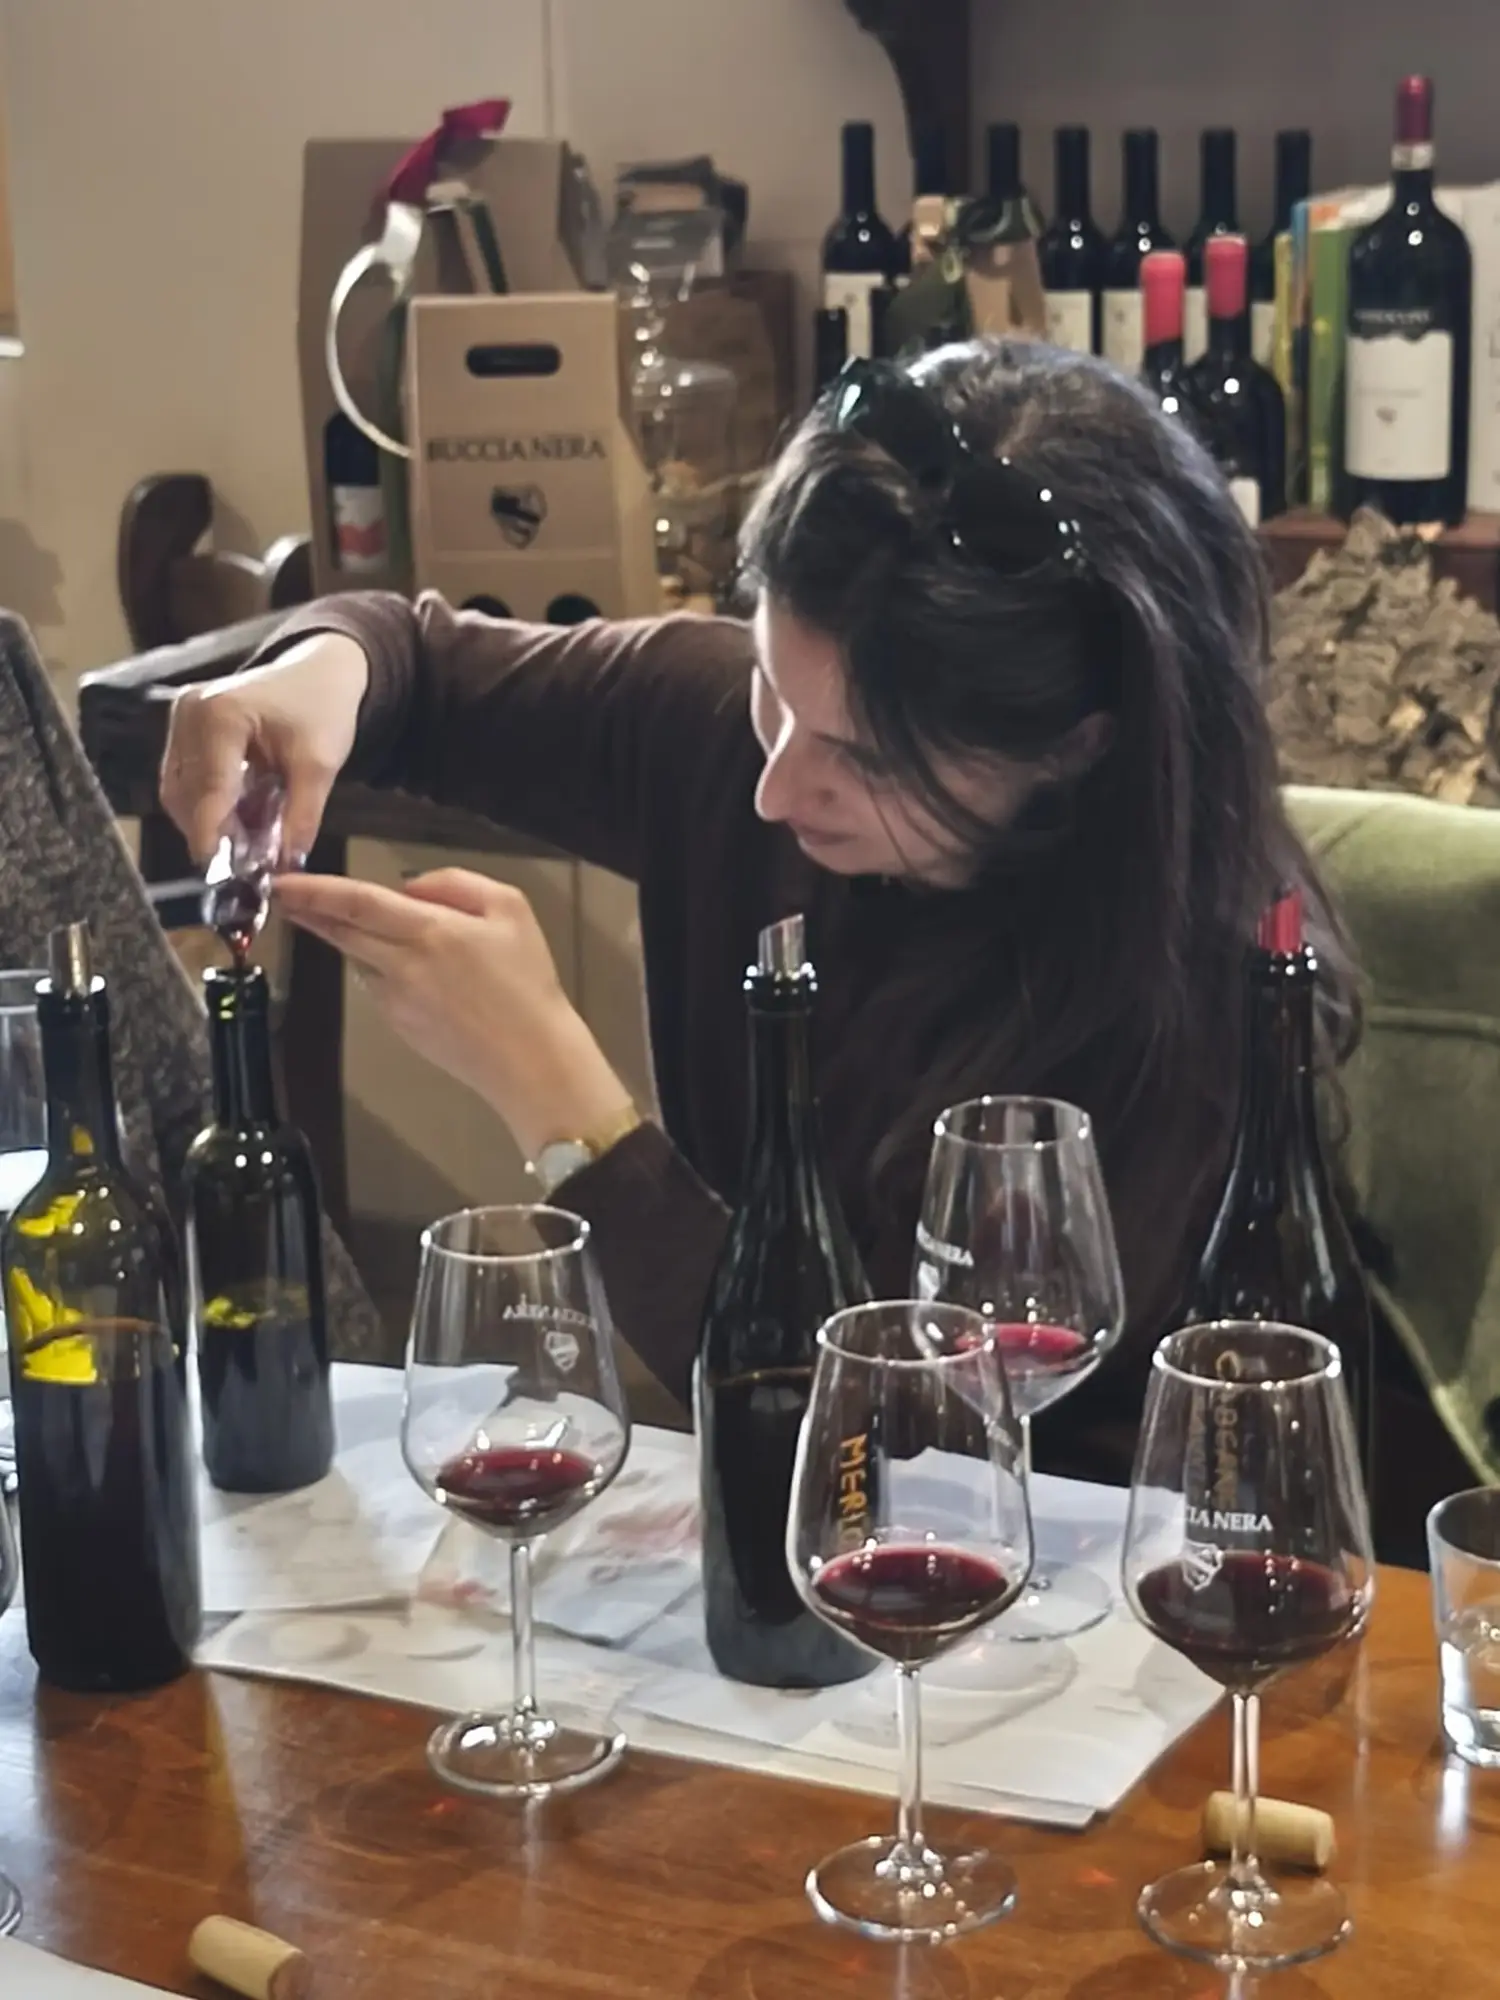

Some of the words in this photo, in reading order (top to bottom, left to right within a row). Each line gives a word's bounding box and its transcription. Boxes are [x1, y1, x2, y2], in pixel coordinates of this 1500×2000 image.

[427, 437, 527, 462] BUCCIA
[531, 434, 607, 461] NERA
[1211, 1510, 1273, 1532] NERA
